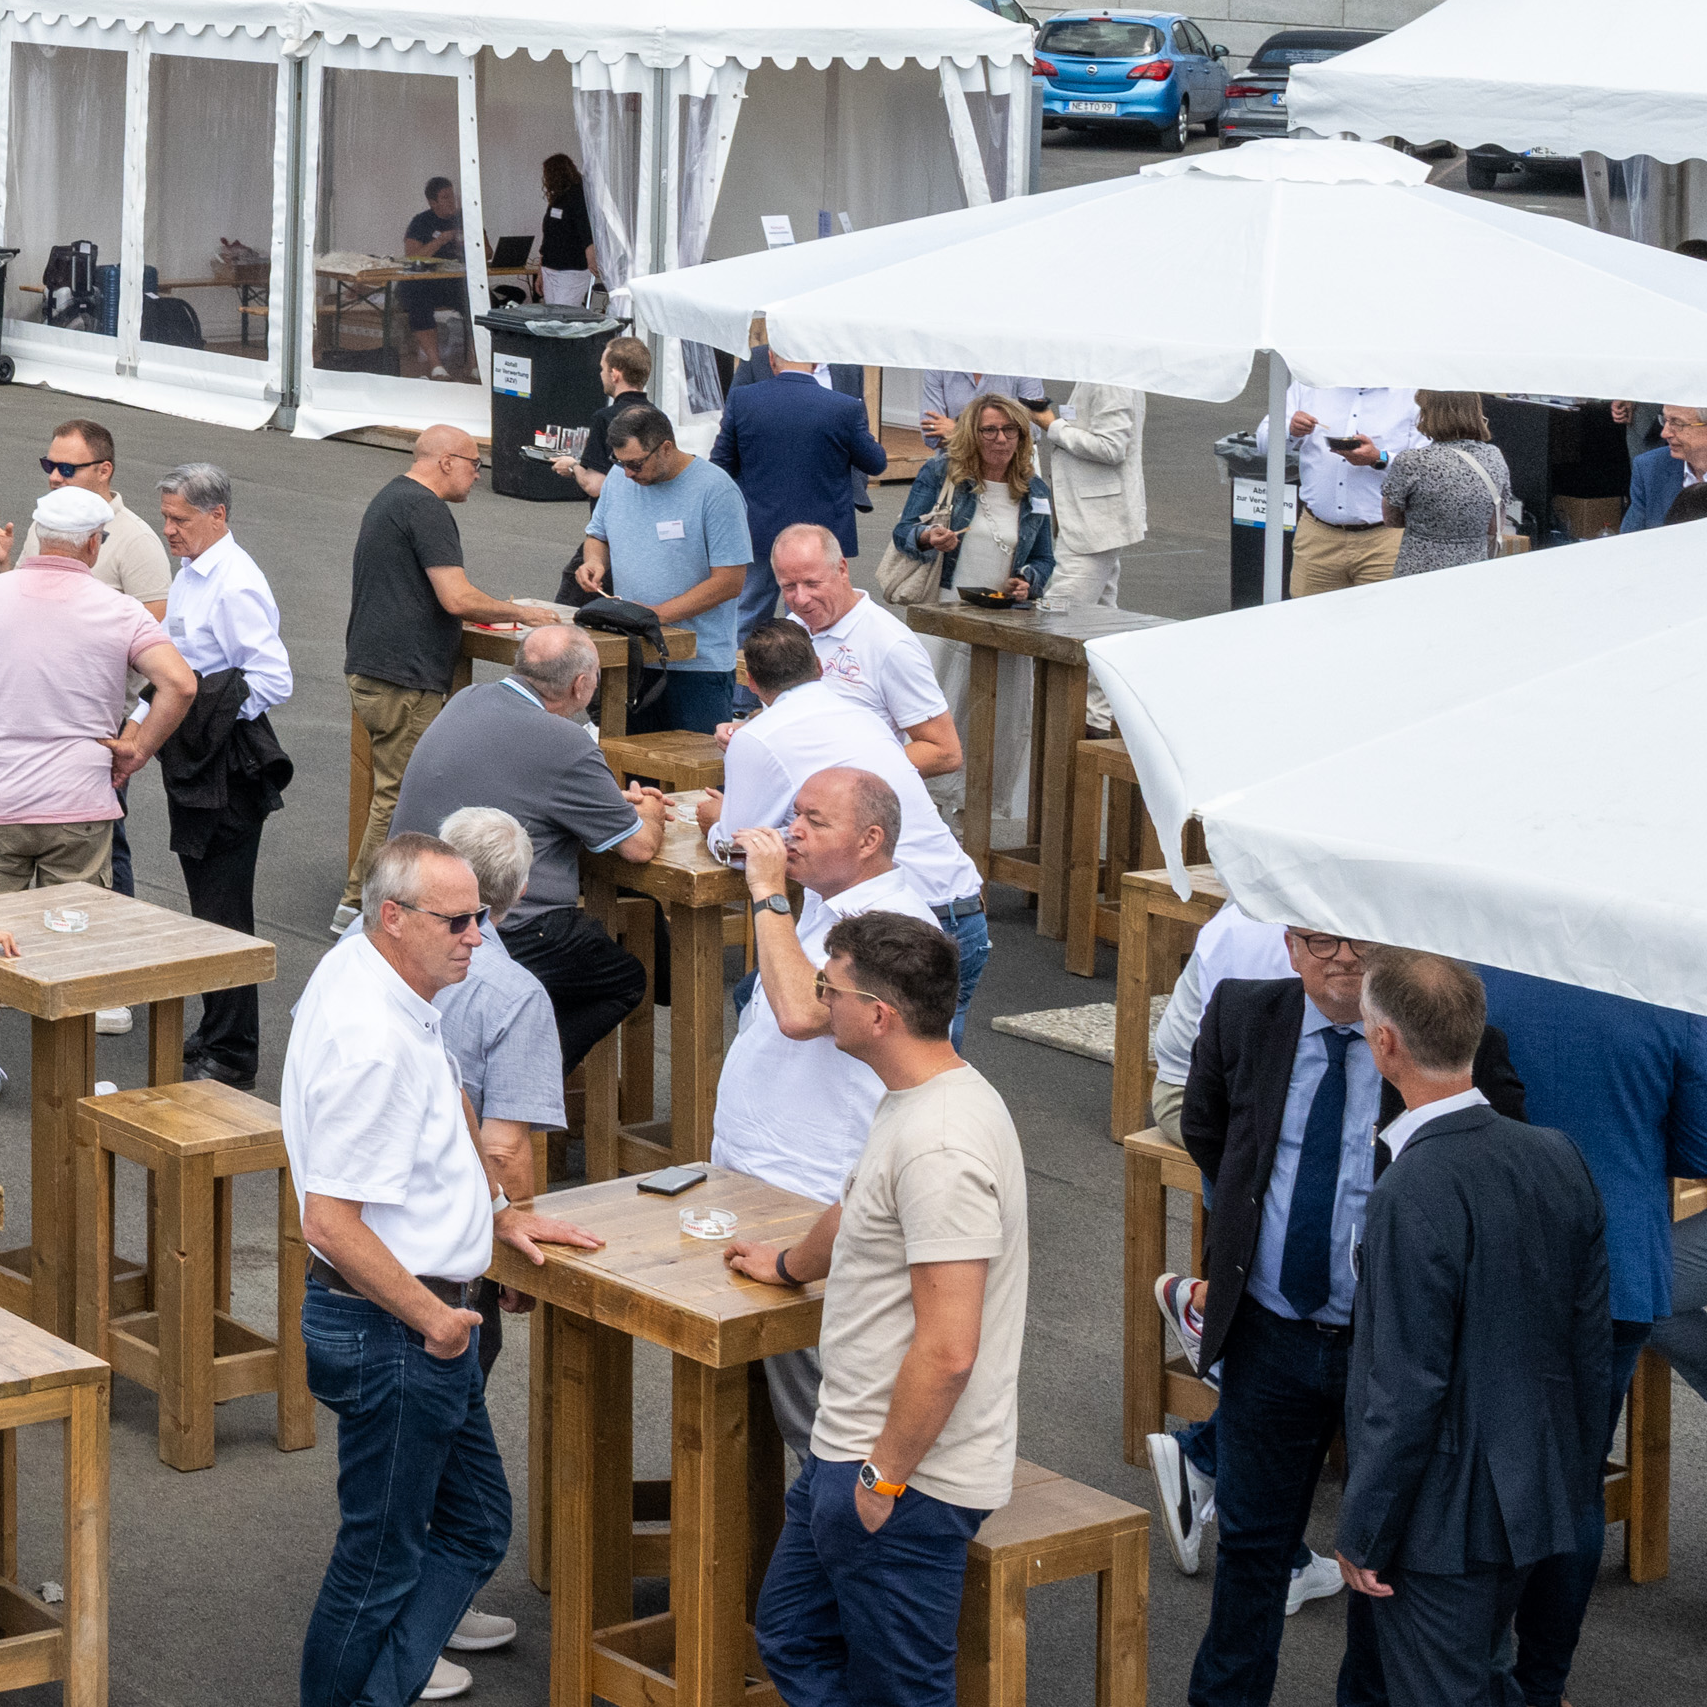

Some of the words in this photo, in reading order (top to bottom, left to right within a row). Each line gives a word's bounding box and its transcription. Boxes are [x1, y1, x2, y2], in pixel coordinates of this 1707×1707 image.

[1072, 102, 1083, 111] NE
[1101, 103, 1113, 112] 99
[504, 360, 518, 368] Abfall
[502, 369, 529, 379] Verwertung
